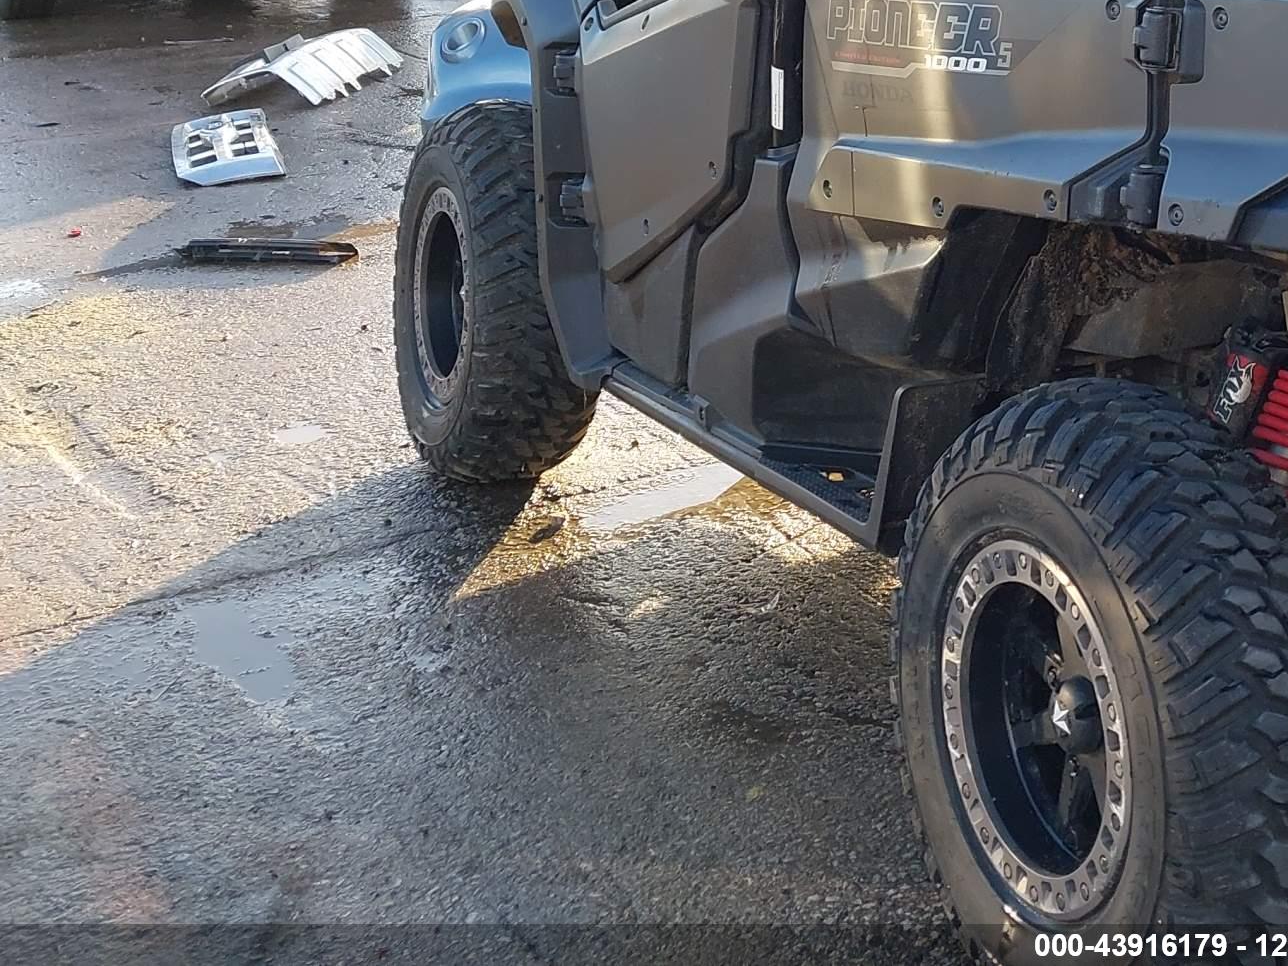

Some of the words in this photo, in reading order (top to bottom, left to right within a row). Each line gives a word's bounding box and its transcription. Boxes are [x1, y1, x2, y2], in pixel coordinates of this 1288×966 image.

[924, 54, 987, 73] 1000
[997, 42, 1013, 68] 5
[1213, 355, 1257, 424] FOX
